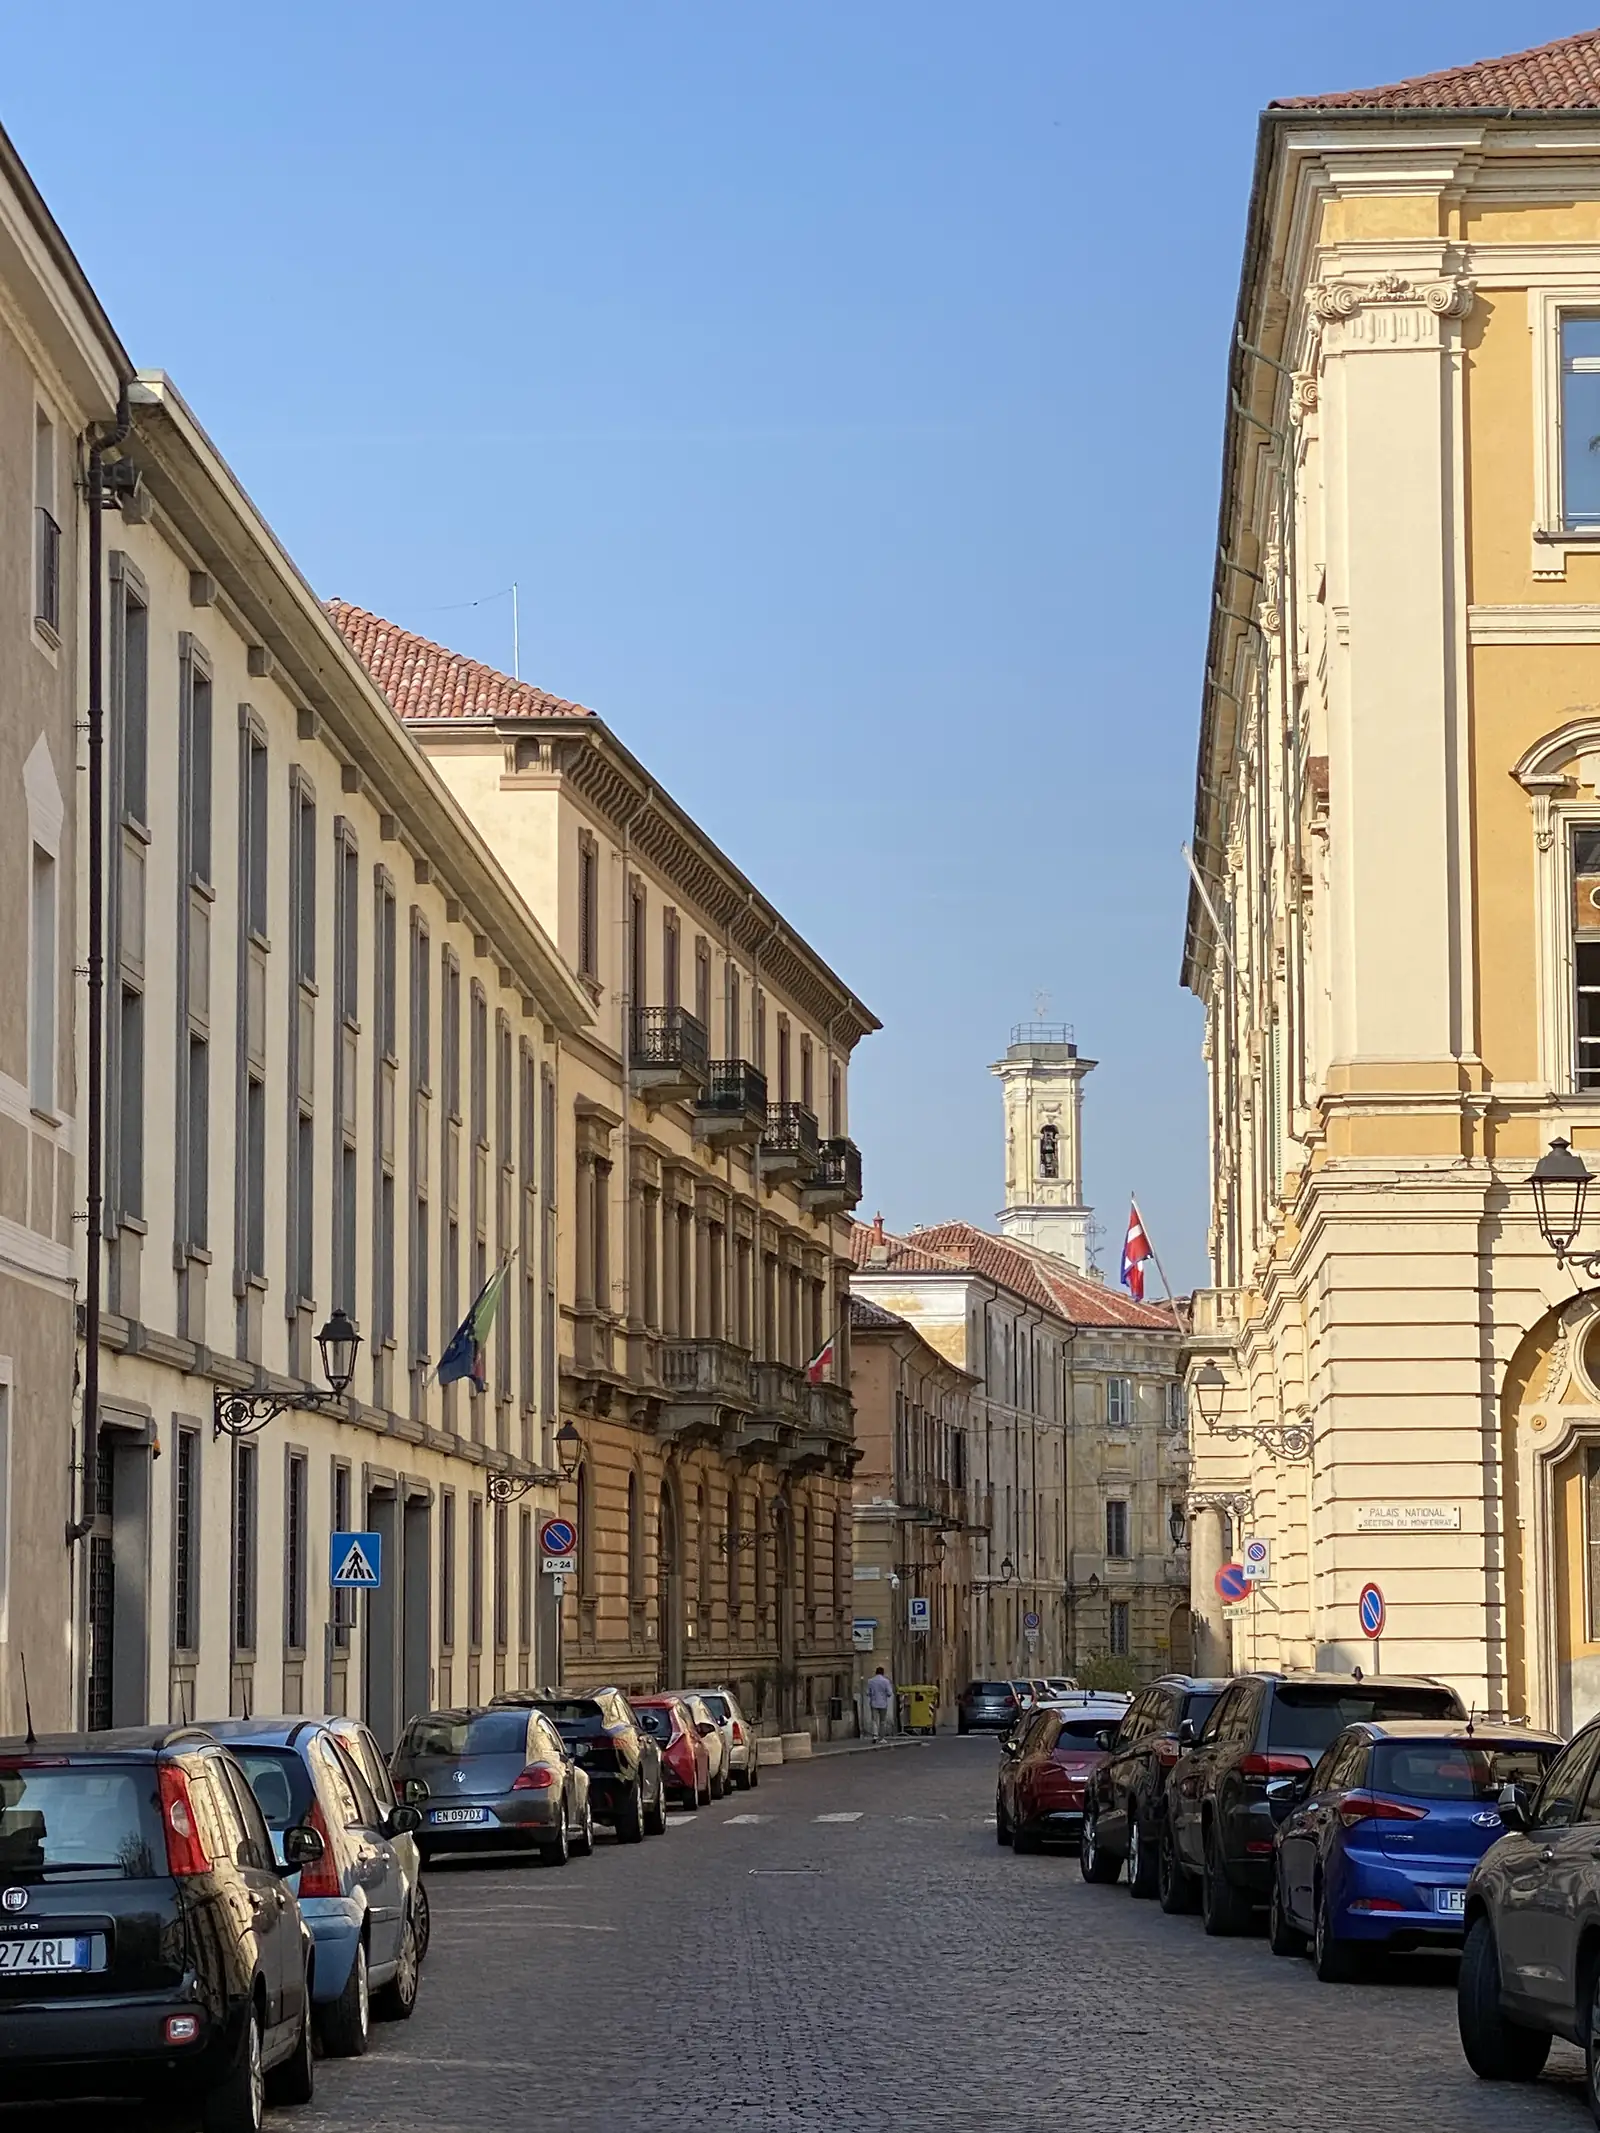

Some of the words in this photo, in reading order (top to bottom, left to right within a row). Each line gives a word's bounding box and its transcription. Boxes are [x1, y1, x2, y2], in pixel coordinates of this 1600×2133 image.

[1369, 1508, 1400, 1517] PALAIS
[1405, 1508, 1445, 1517] NATIONAL
[1363, 1519, 1394, 1527] SECTION
[1411, 1518, 1453, 1526] MONFERRAT
[914, 1602, 924, 1614] P
[436, 1811, 449, 1822] EN
[0, 1941, 71, 1968] 274RL
